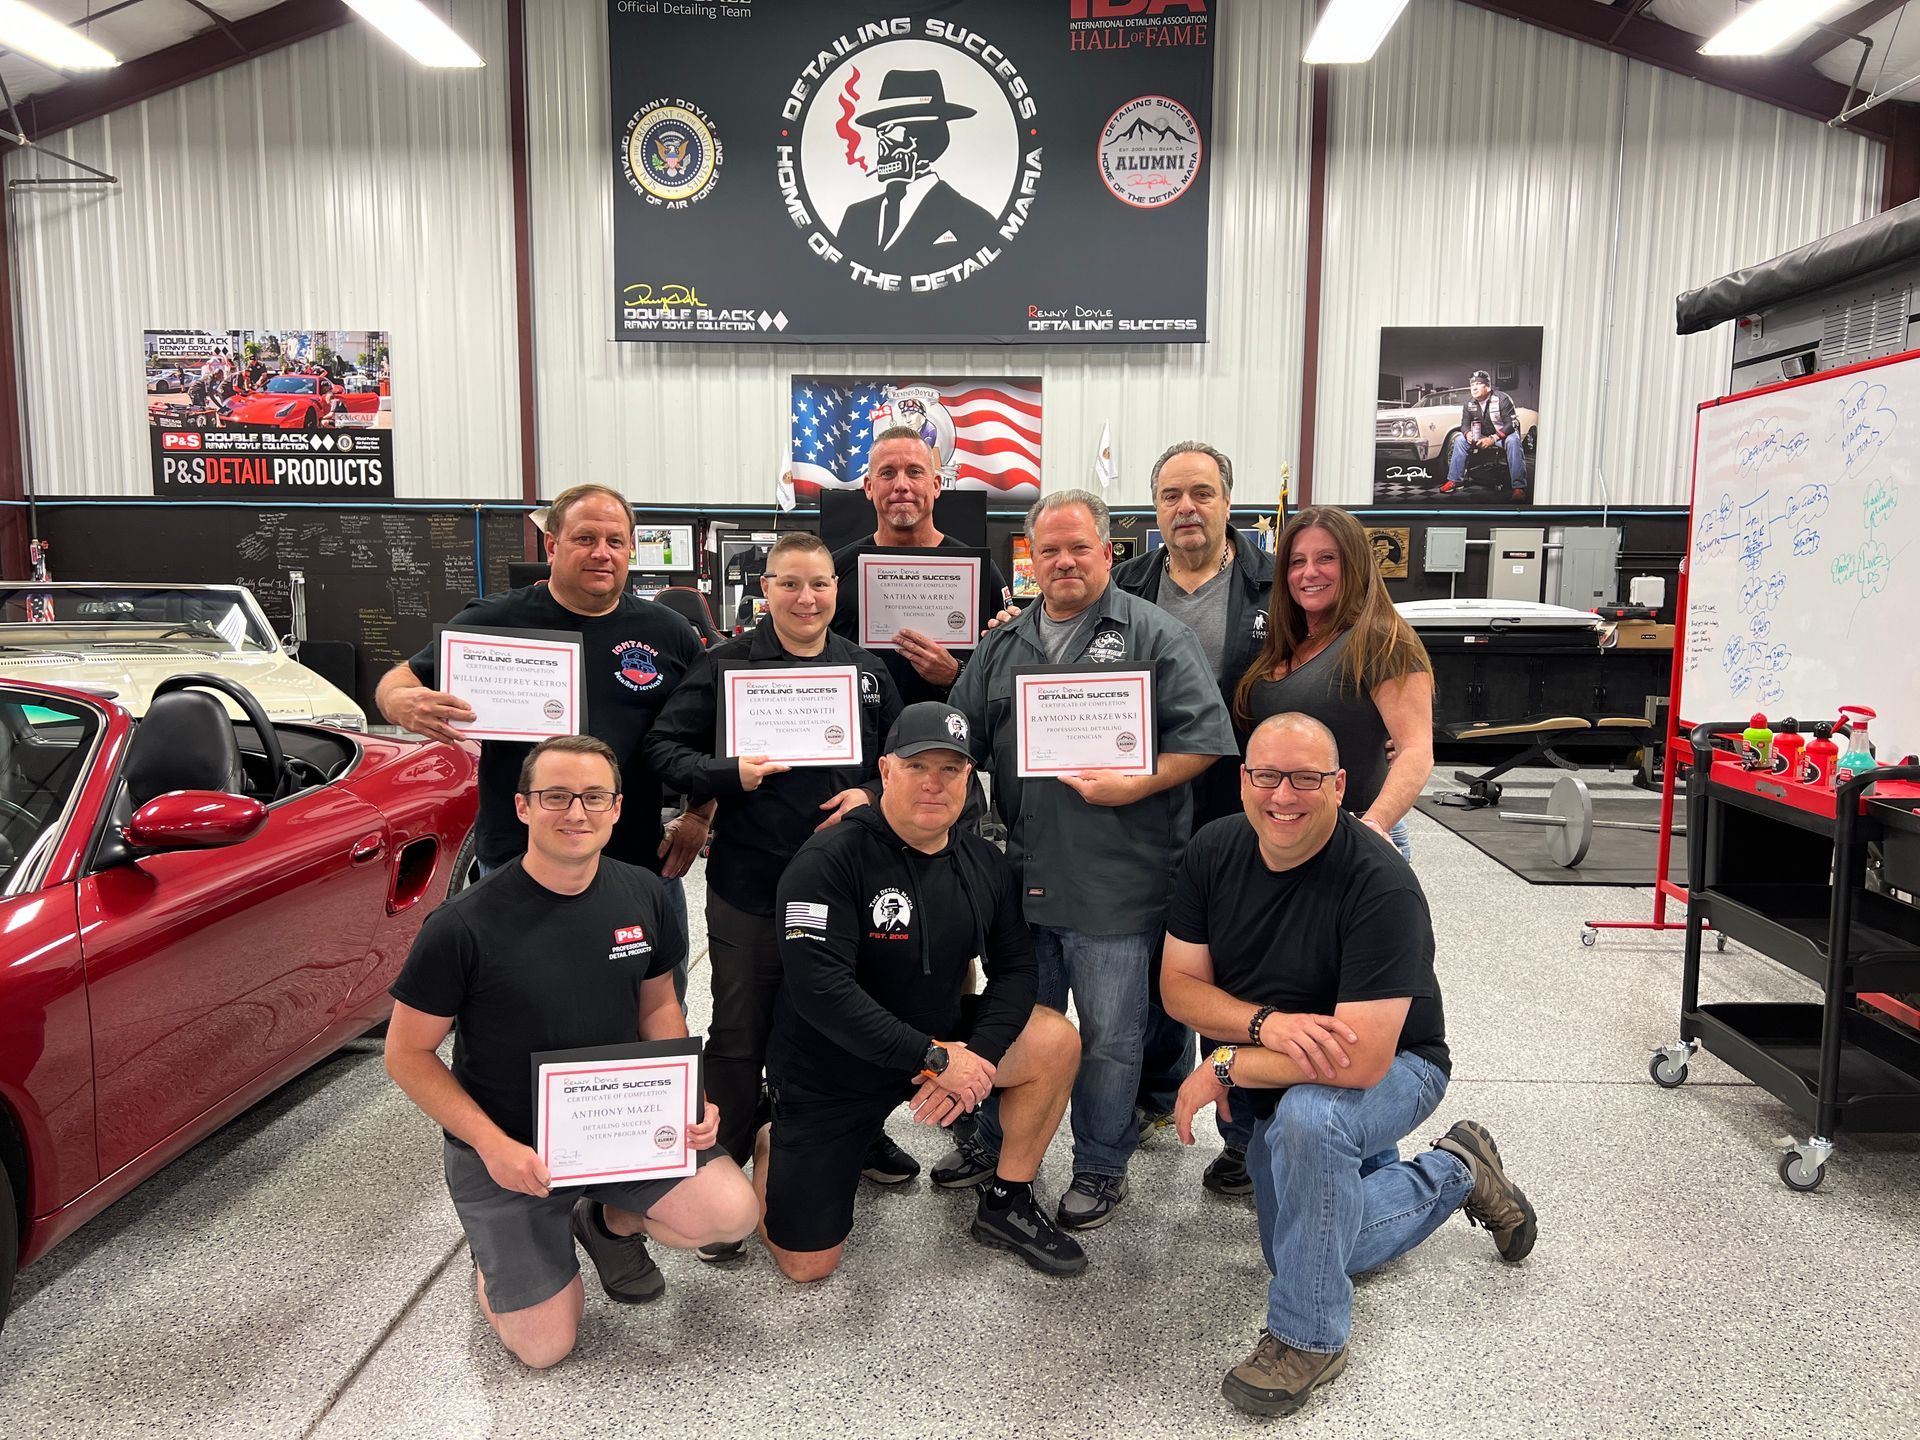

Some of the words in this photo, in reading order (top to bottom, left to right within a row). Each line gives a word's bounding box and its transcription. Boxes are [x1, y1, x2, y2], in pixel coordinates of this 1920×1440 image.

[617, 1, 659, 13] Official
[664, 3, 717, 19] Detailing
[720, 5, 751, 17] Team
[1070, 20, 1123, 30] INTERNATIONAL
[1126, 17, 1161, 27] DETAILING
[1162, 15, 1208, 25] ASSOCIATION
[1070, 28, 1130, 51] HALL
[1131, 31, 1145, 42] OF
[1145, 24, 1207, 48] FAME
[781, 17, 911, 122] DETAILING
[925, 18, 1038, 120] SUCCESS
[626, 97, 669, 130] RENNY
[676, 98, 716, 130] DOYLE
[1105, 99, 1152, 137] DETAILING
[1156, 99, 1196, 135] SUCCESS
[636, 110, 673, 142] PRESIDENT
[1115, 155, 1185, 171] ALUMNI
[620, 136, 644, 196] DETAILER
[645, 194, 662, 206] OF
[666, 200, 689, 209] AIR
[691, 168, 720, 203] FORCE
[713, 137, 724, 165] ONE
[1101, 152, 1115, 182] HOME
[1113, 182, 1126, 194] OF
[1127, 192, 1146, 203] THE
[1149, 186, 1181, 204] DETAIL
[1181, 151, 1198, 185] MAFIA
[776, 145, 812, 229] HOME
[807, 231, 844, 263] OF
[849, 260, 902, 292] THE
[910, 246, 1003, 292] DETAIL
[998, 147, 1043, 242] MAFIA
[624, 308, 691, 320] DOUBLE
[696, 309, 756, 321] BLACK
[624, 321, 658, 329] RENNY
[662, 321, 694, 330] DOYLE
[696, 322, 756, 331] COLLECTION
[1028, 320, 1113, 331] DETAILING
[1118, 319, 1198, 330] SUCCESS
[165, 434, 200, 448] P&S
[204, 433, 259, 443] DOUBLE
[262, 433, 309, 443] BLACK
[205, 442, 233, 450] RENNY
[235, 442, 261, 450] DOYLE
[262, 442, 309, 450] COLLECTION
[463, 654, 512, 663] DETAILING
[515, 658, 559, 666] SUCCESS
[465, 663, 506, 671] CERTIFICATE
[452, 674, 492, 683] WILLIAM
[494, 678, 531, 686] JEFFREY
[533, 680, 568, 688] KETRON
[470, 688, 515, 697] PROFESSIONAL
[517, 690, 550, 698] DETAILING
[1086, 691, 1129, 699] SUCCESS
[749, 708, 774, 716] GINA
[788, 707, 835, 715] SANDWITH
[1031, 713, 1077, 722] RAYMOND
[1079, 712, 1137, 721] KRASZEWSKI
[868, 894, 880, 908] THE
[617, 928, 643, 942] P&S
[608, 951, 628, 960] DETAIL
[627, 946, 652, 956] PRODUCTS
[612, 941, 649, 953] PROFESSIONAL
[563, 1083, 619, 1094] DETAILING
[622, 1079, 672, 1089] SUCCESS
[567, 1094, 612, 1103] CERTIFICATE
[623, 1089, 668, 1098] COMPLETION
[571, 1108, 624, 1120] ANTHONY
[626, 1104, 663, 1114] MAZEL
[582, 1122, 620, 1132] DETAILING
[621, 1120, 652, 1128] SUCCESS
[586, 1132, 612, 1140] INTERN
[613, 1129, 647, 1139] PROGRAM
